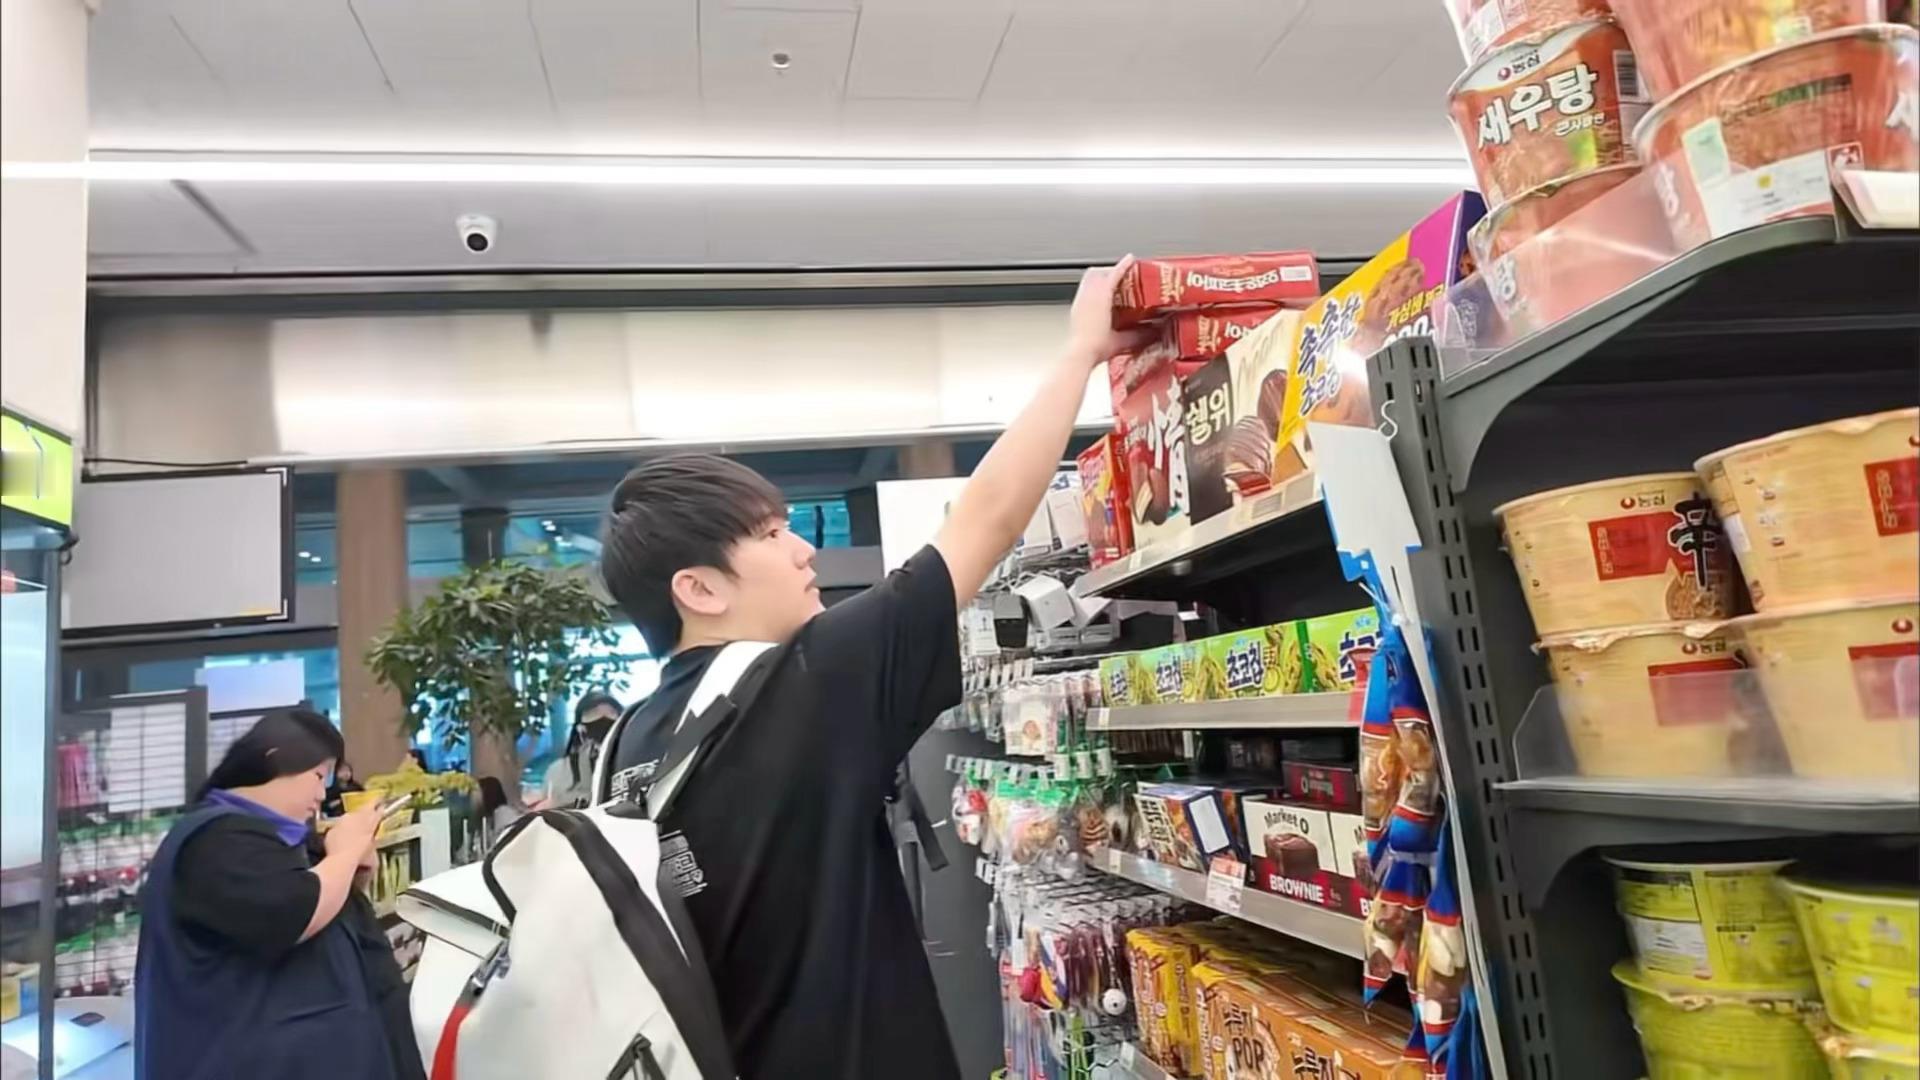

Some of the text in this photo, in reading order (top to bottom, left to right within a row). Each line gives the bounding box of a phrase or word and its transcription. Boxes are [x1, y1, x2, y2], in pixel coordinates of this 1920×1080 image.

[1478, 63, 1598, 150] 새우탕
[1298, 295, 1361, 378] 촉촉한
[1264, 808, 1309, 835] Market O
[1269, 874, 1325, 904] BROWNIE
[1232, 1037, 1265, 1073] POP
